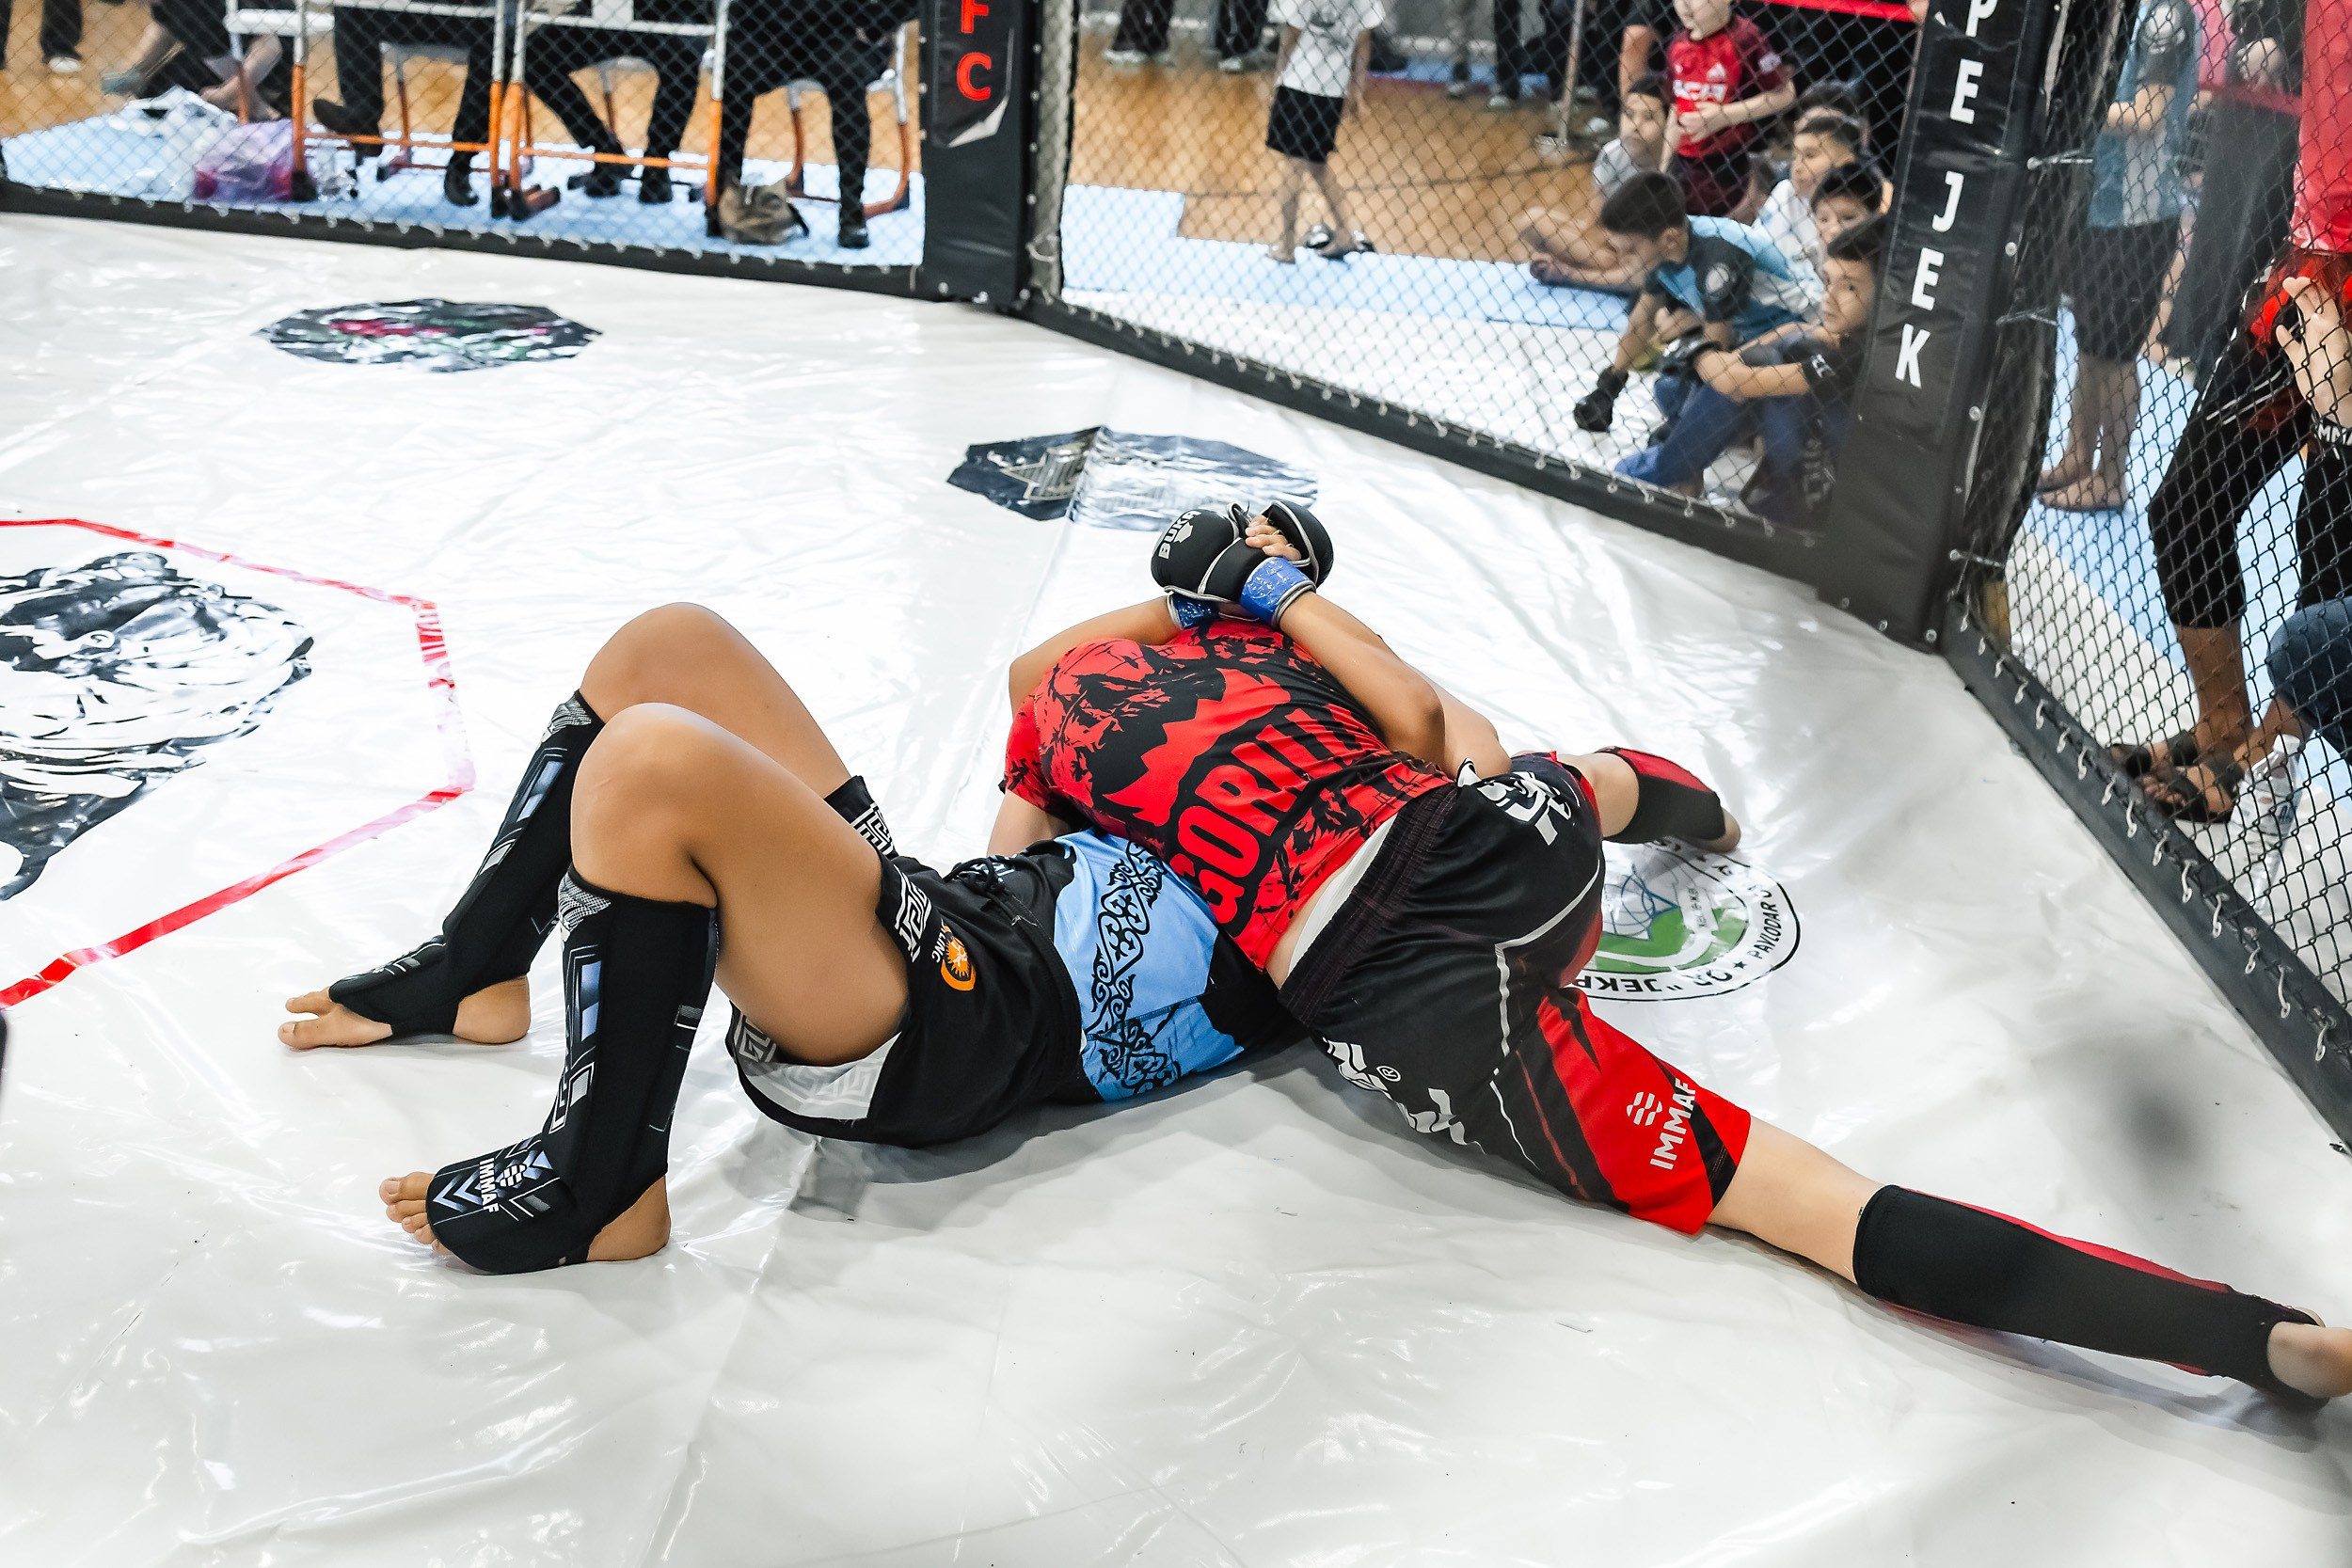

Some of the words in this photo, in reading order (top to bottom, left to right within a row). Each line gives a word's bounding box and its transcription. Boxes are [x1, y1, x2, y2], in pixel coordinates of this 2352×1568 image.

[1747, 901, 1782, 959] PAVLODAR
[1649, 1077, 1696, 1170] IMMAF
[479, 1157, 500, 1213] IMMAF
